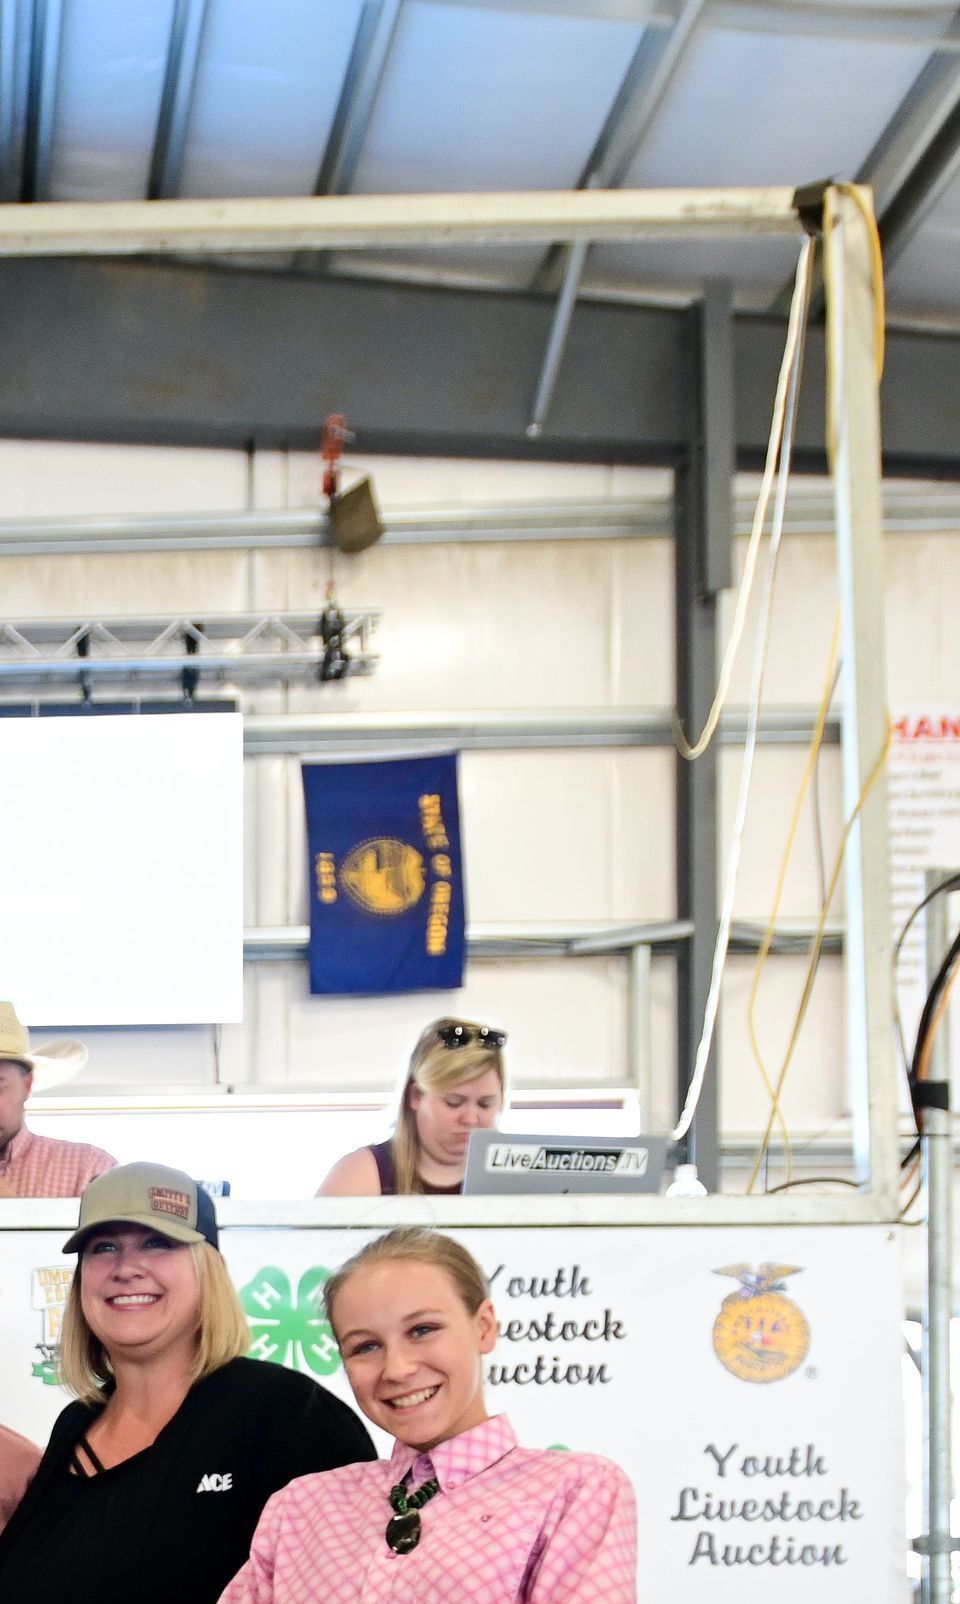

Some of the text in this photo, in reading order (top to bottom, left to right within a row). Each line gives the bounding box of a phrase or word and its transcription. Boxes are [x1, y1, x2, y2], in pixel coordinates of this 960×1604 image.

[419, 794, 452, 957] STATE OF OREGON
[488, 1355, 613, 1385] uction
[704, 1443, 830, 1477] Youth
[196, 1473, 233, 1493] ACE
[671, 1486, 864, 1521] Livestock
[689, 1531, 848, 1565] Auction
